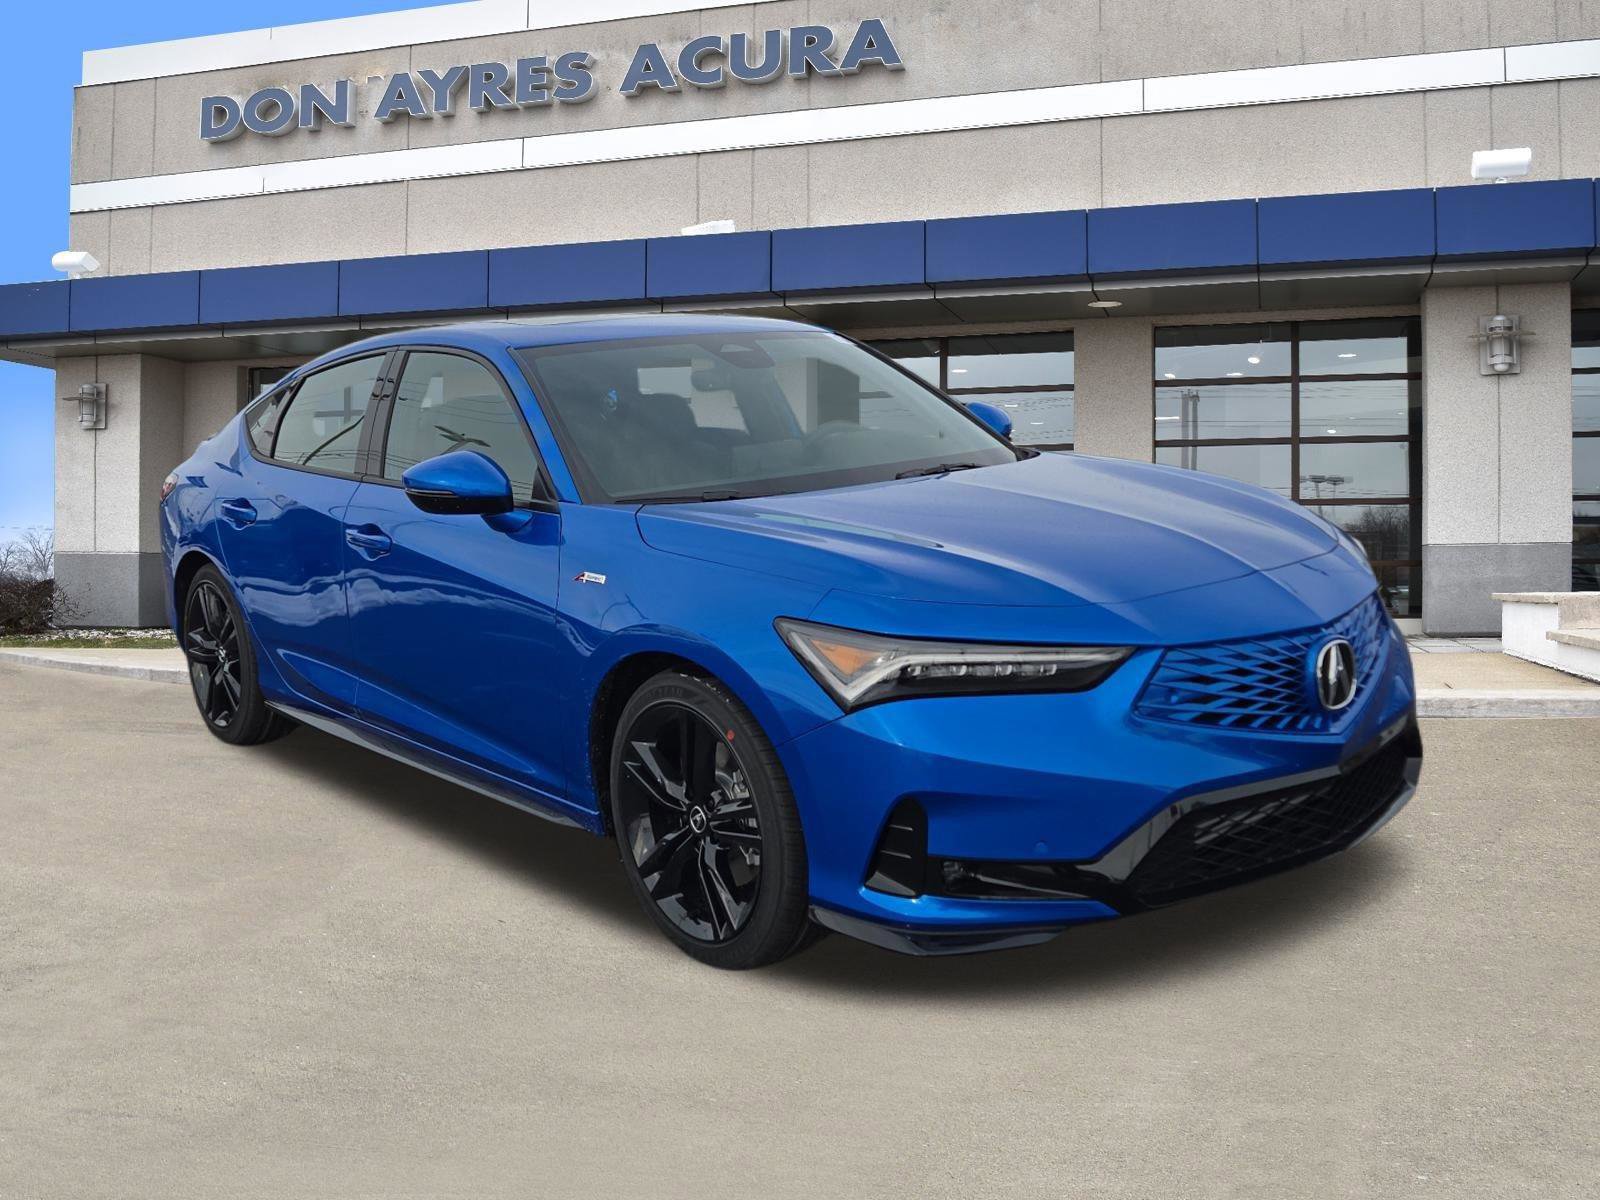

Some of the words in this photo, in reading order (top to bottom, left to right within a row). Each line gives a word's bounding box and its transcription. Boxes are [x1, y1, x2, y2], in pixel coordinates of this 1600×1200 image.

[200, 79, 356, 143] DON
[374, 52, 597, 122] AYRES
[619, 18, 905, 97] ACURA
